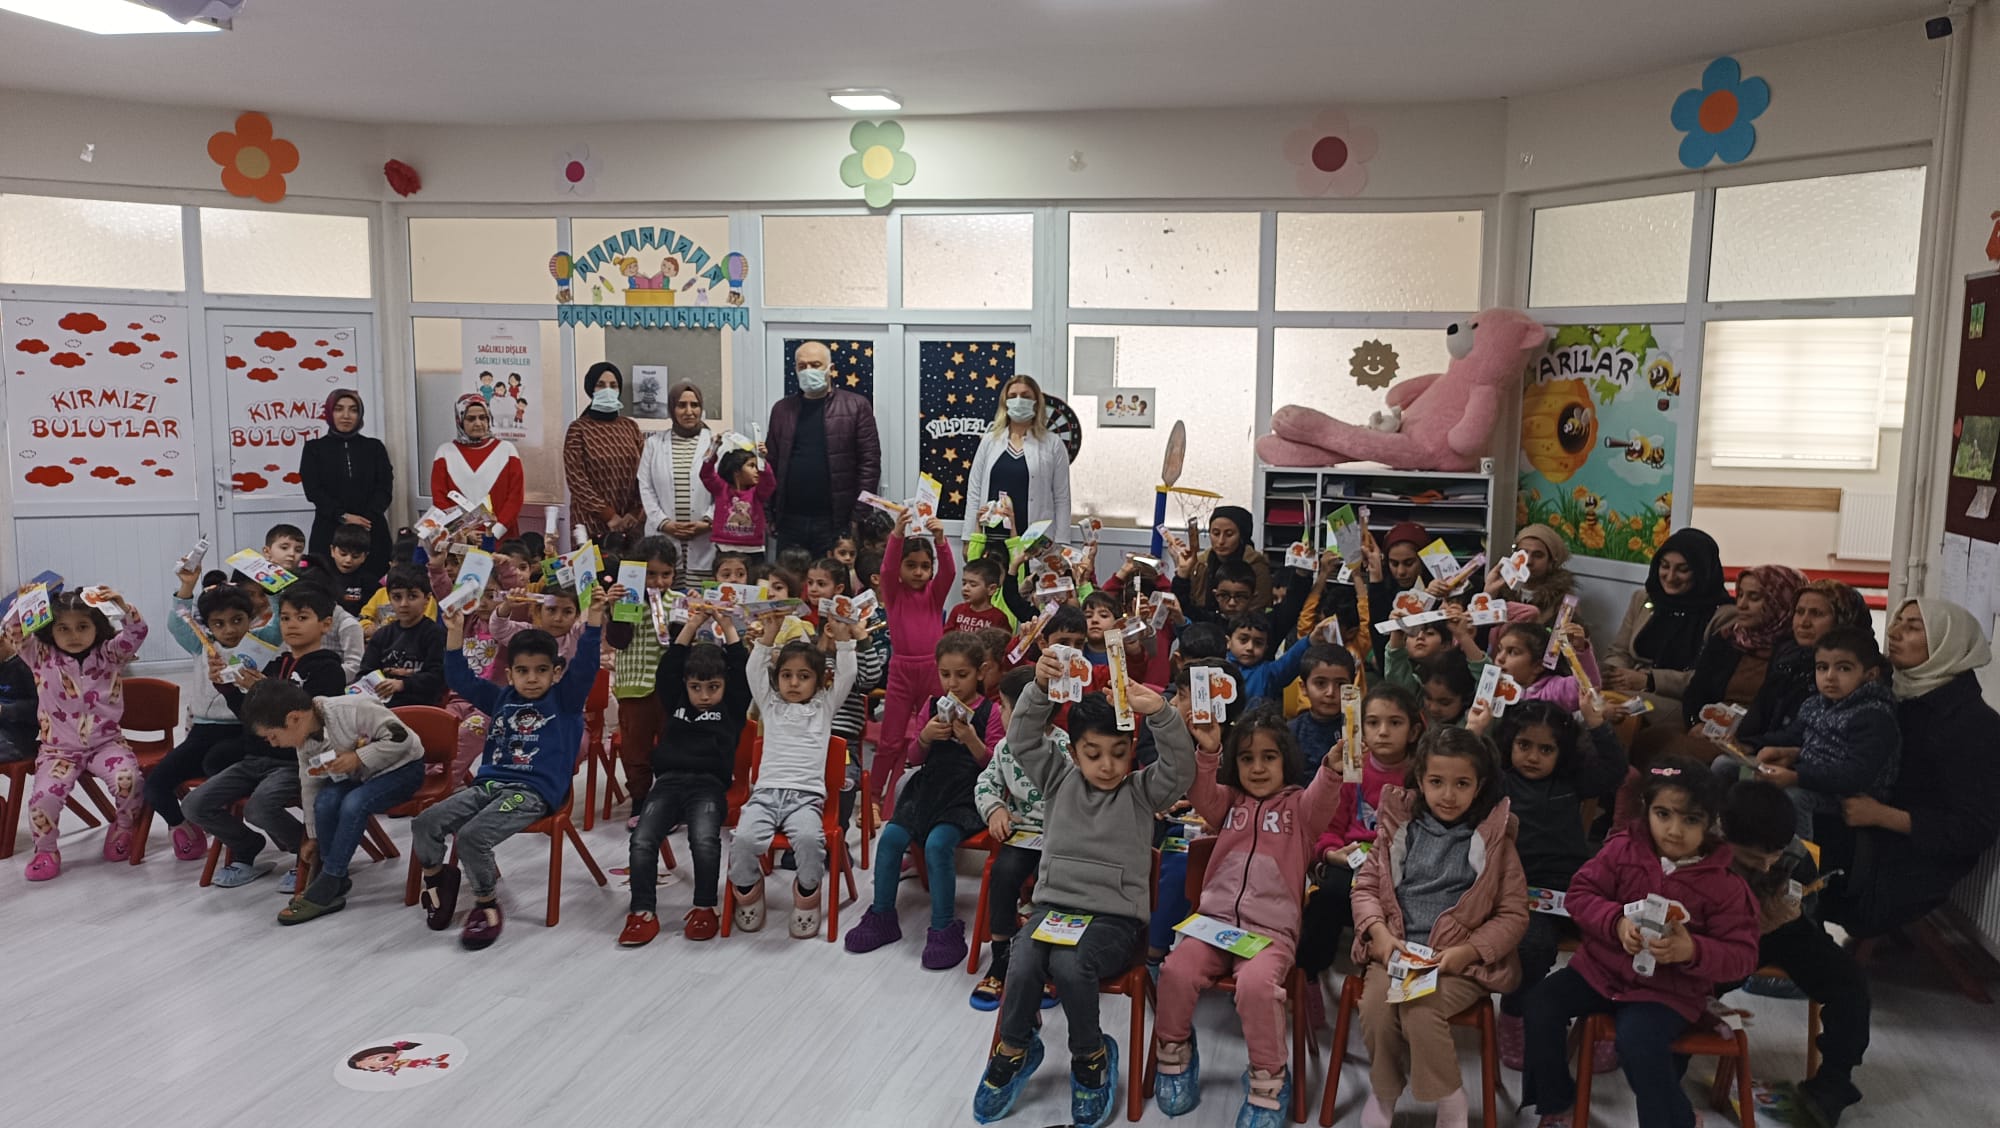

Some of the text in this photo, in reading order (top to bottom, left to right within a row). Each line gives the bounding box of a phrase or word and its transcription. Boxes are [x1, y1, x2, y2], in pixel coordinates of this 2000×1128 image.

[562, 309, 744, 322] ZENGİNLİKLERİ
[477, 344, 528, 355] SAĞLIKLI DİŞLER
[1540, 349, 1634, 385] ARILAR
[50, 388, 157, 414] KIRMIZI
[247, 401, 328, 424] KIRMIZ
[31, 418, 179, 439] BULUTLAR
[927, 418, 995, 439] YILDIZL
[956, 614, 992, 629] BREAK
